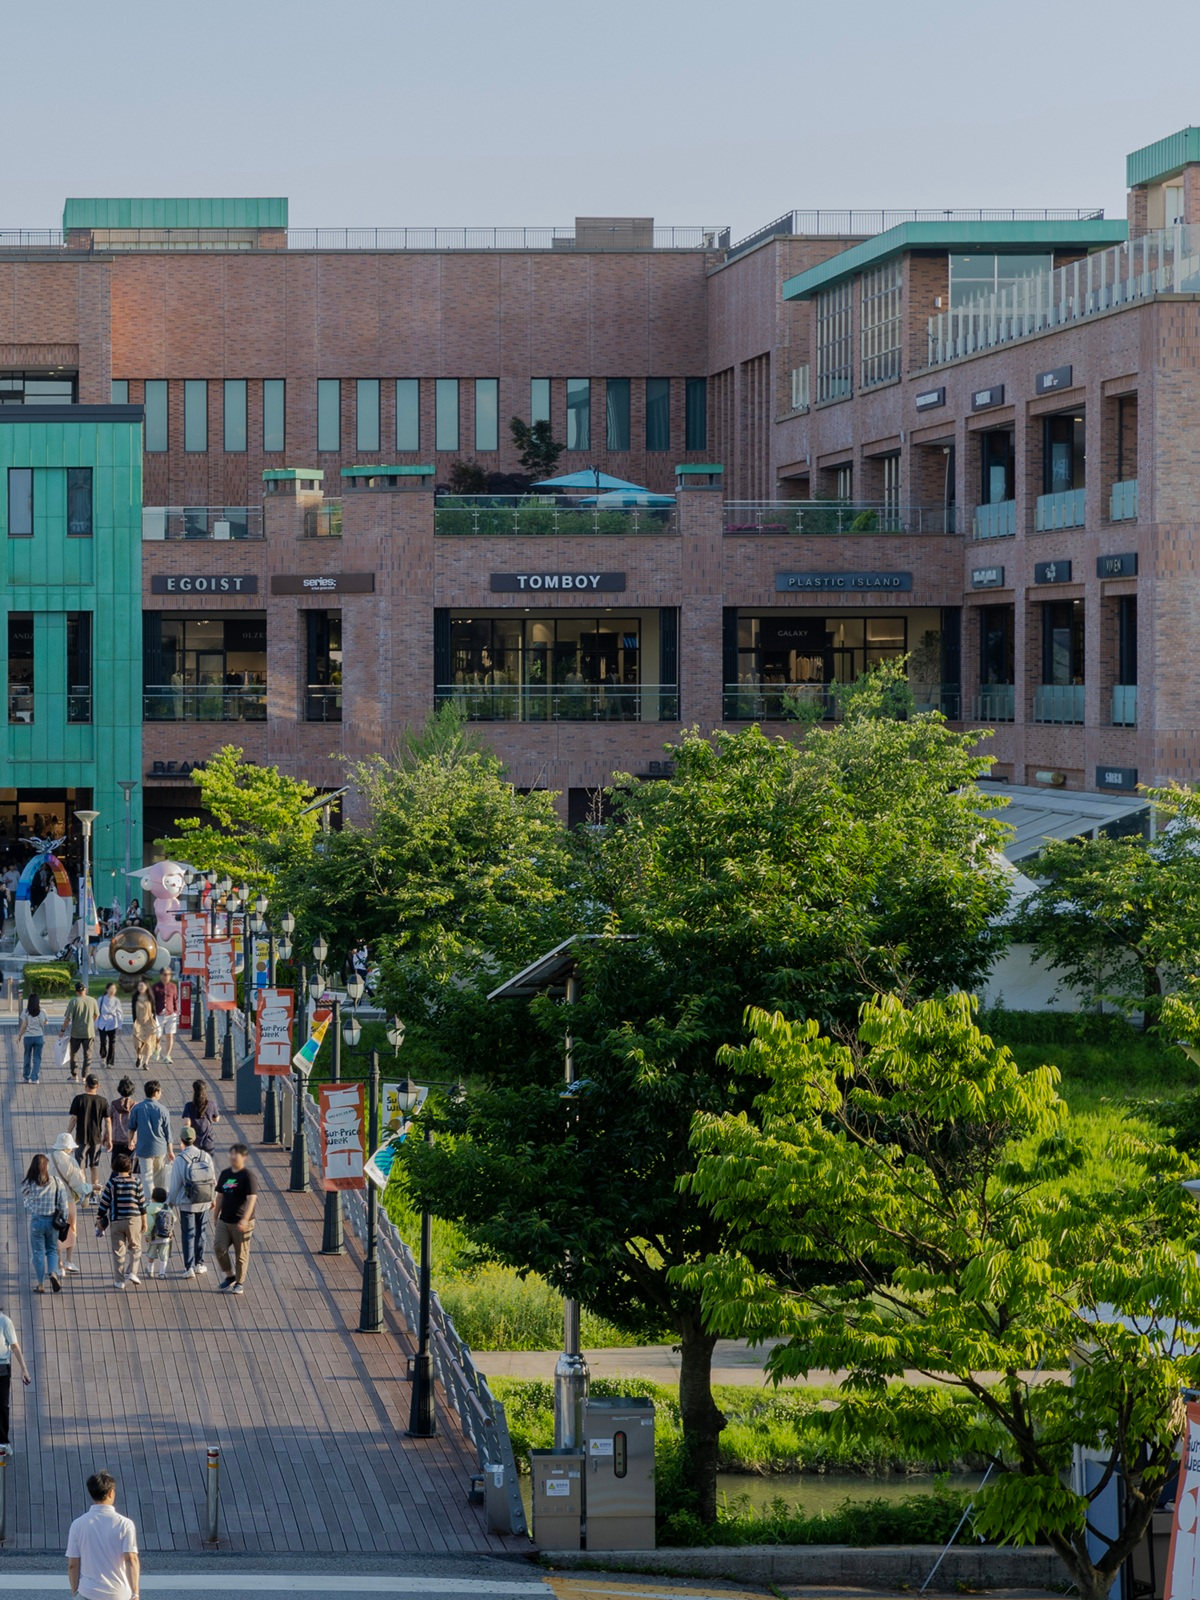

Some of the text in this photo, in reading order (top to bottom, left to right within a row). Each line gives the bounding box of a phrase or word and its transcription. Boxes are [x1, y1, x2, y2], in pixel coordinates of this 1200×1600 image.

[167, 578, 244, 591] EGOIST
[516, 575, 601, 589] TOMBOY
[788, 578, 901, 587] PLASTIC ISLAND
